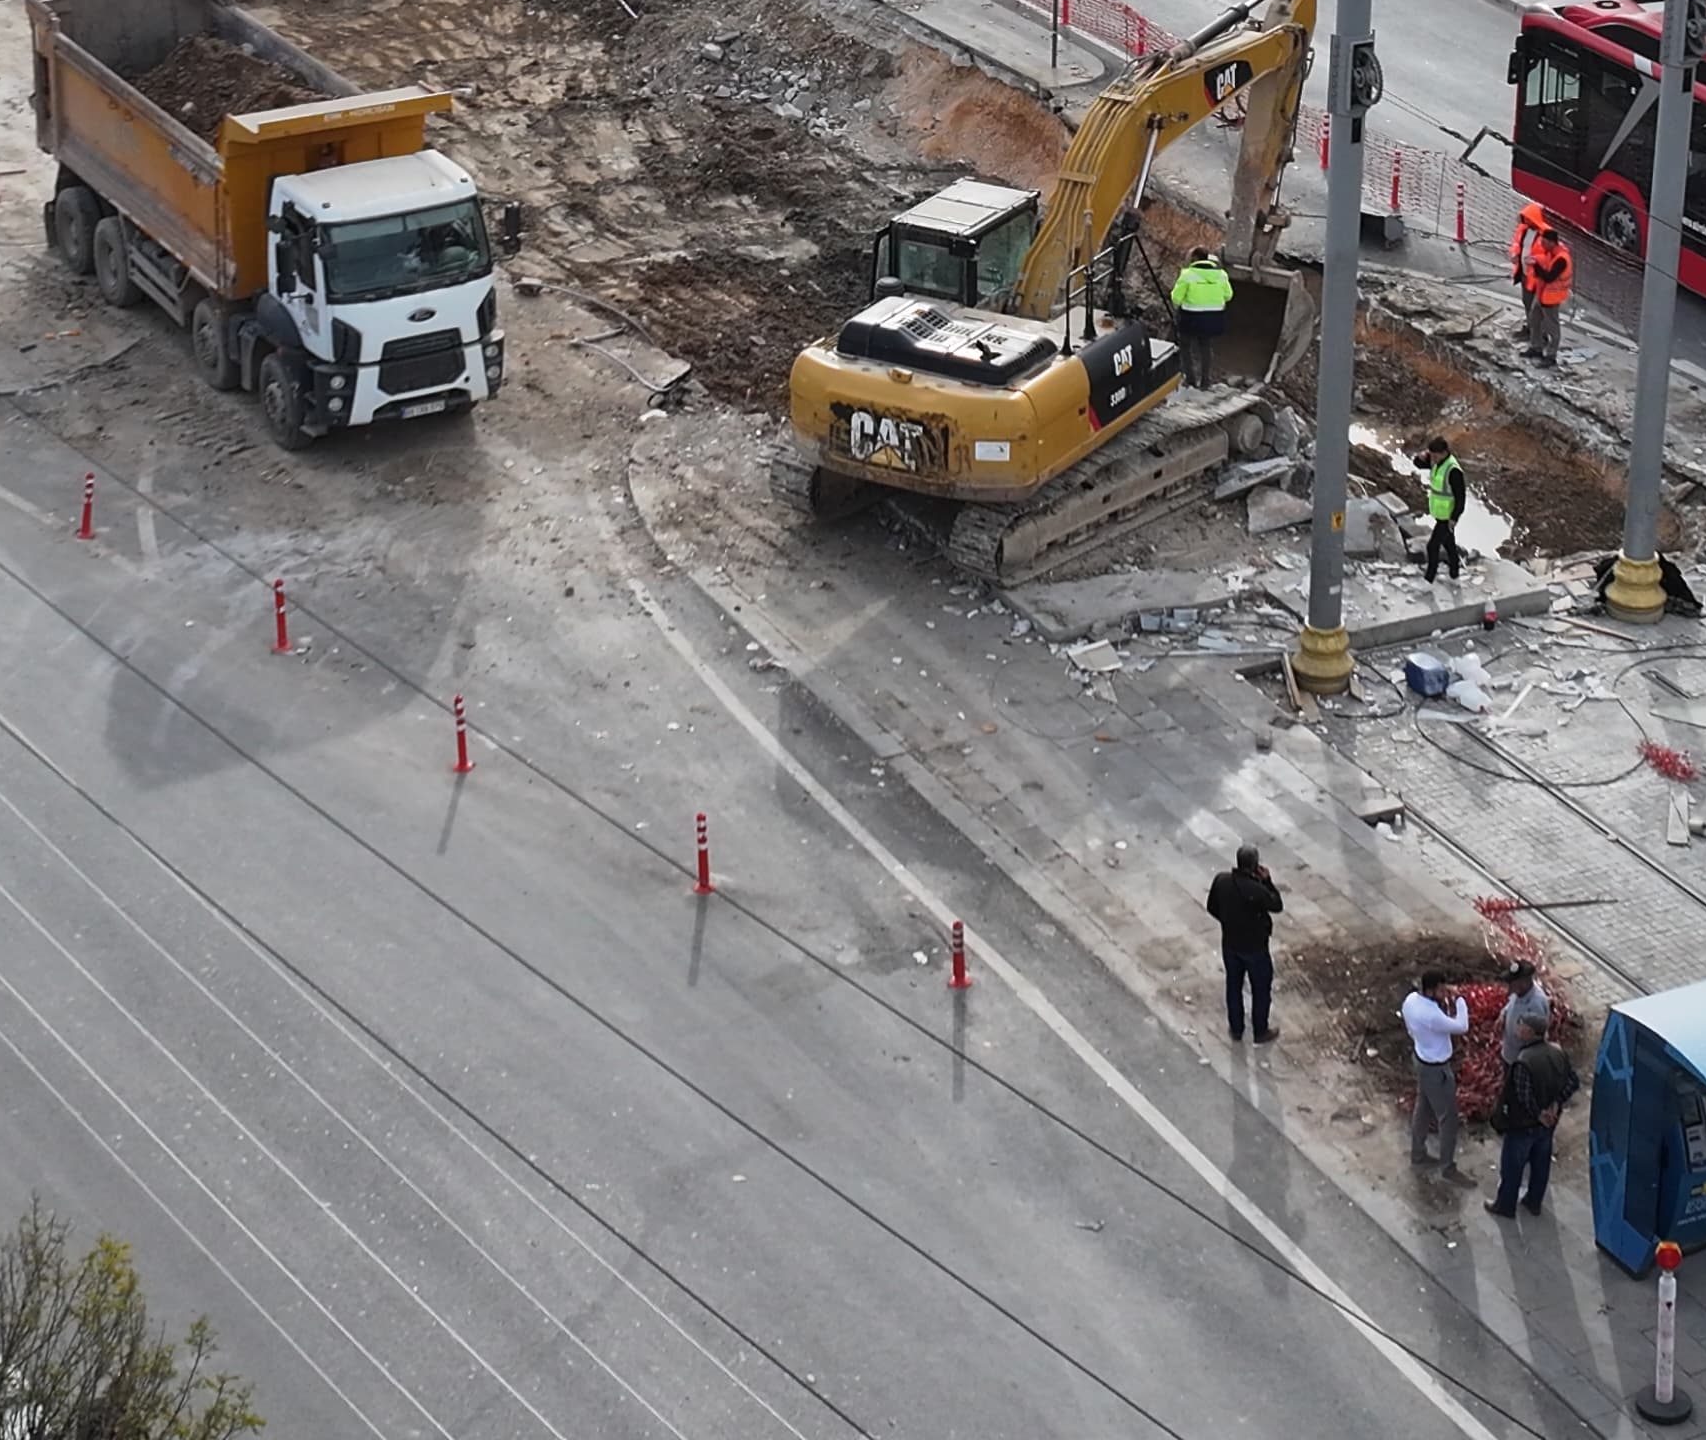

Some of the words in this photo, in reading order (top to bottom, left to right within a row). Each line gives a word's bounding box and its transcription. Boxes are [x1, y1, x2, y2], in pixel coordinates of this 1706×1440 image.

[1216, 63, 1237, 101] CAT
[1113, 344, 1133, 377] CAT
[851, 410, 924, 472] CAT
